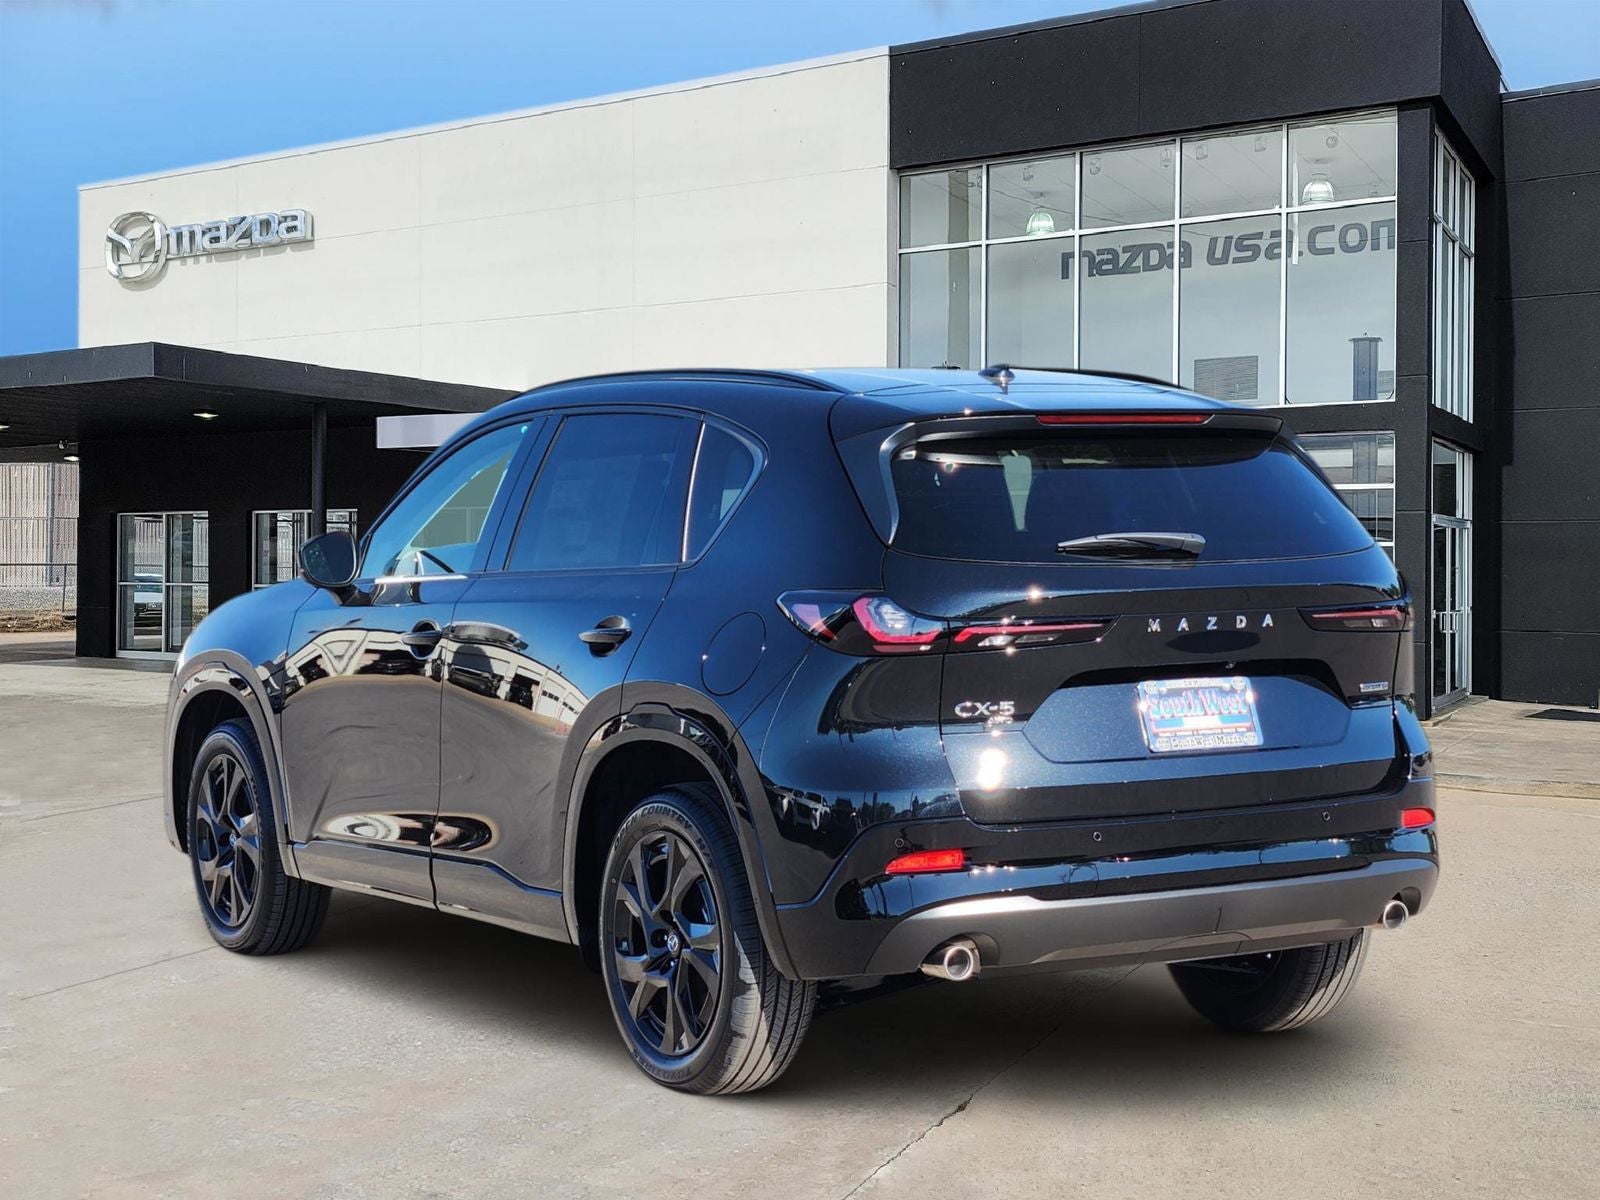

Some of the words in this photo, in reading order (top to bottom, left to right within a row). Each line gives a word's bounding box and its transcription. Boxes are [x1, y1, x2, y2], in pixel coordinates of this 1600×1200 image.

[1147, 613, 1274, 633] MAZDA
[954, 701, 1015, 718] CX-5
[640, 805, 693, 830] COUNTRY
